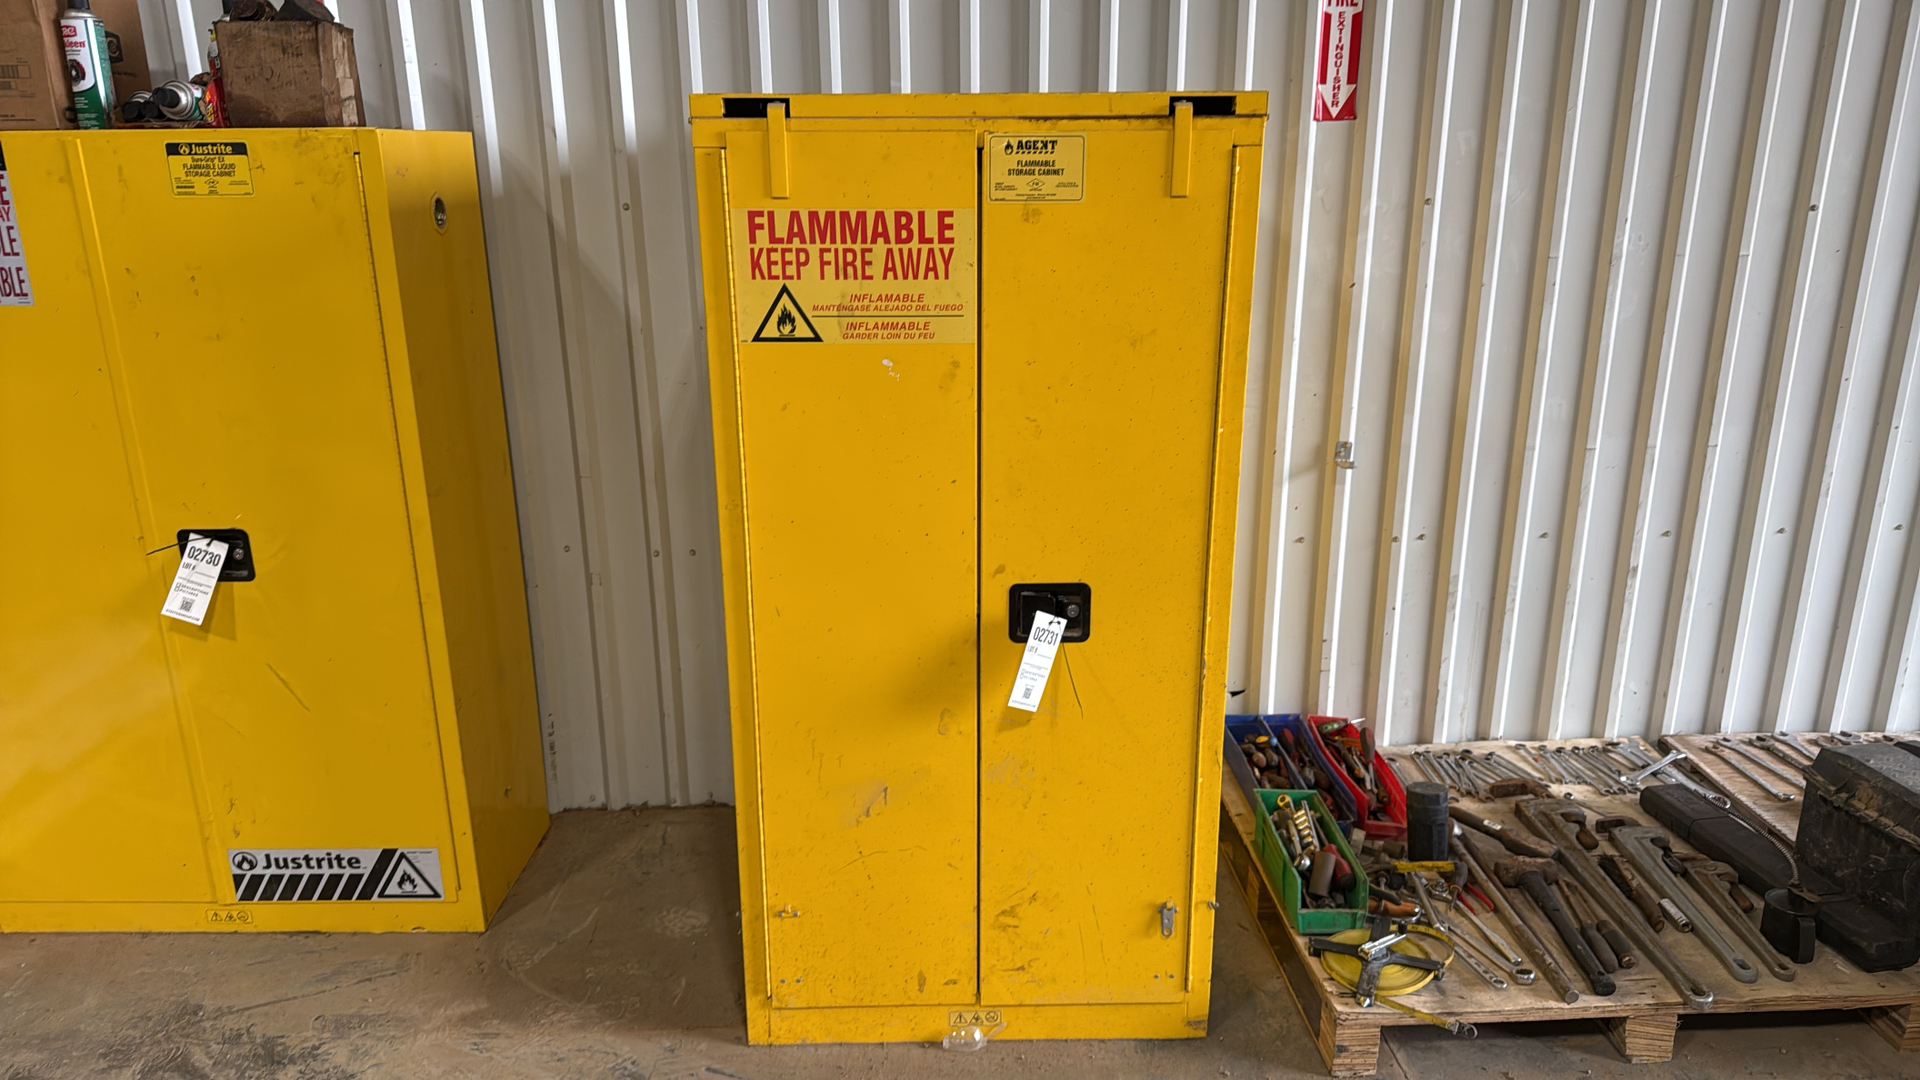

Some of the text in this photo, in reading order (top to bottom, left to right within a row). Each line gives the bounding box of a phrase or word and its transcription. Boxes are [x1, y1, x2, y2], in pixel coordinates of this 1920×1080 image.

[1331, 11, 1346, 108] EXTINGUISHER
[190, 144, 233, 154] Justrite
[1016, 140, 1058, 150] AGENT
[1007, 168, 1065, 176] STORAGE CABINET
[747, 210, 955, 245] FLAMMABLE
[0, 225, 20, 257] LE
[749, 248, 955, 281] KEEP FIRE AWAY
[849, 293, 925, 303] INFLAMABLE
[873, 304, 912, 312] ALEJADO
[914, 304, 932, 312] DEL
[933, 304, 964, 312] FUEGO
[845, 321, 931, 331] INFLAMMABLE
[842, 332, 935, 340] GARDER LOIN DU FEU
[187, 545, 221, 567] 02730
[182, 562, 192, 570] LOT
[1033, 626, 1059, 646] 02731
[262, 852, 362, 870] Justrite
